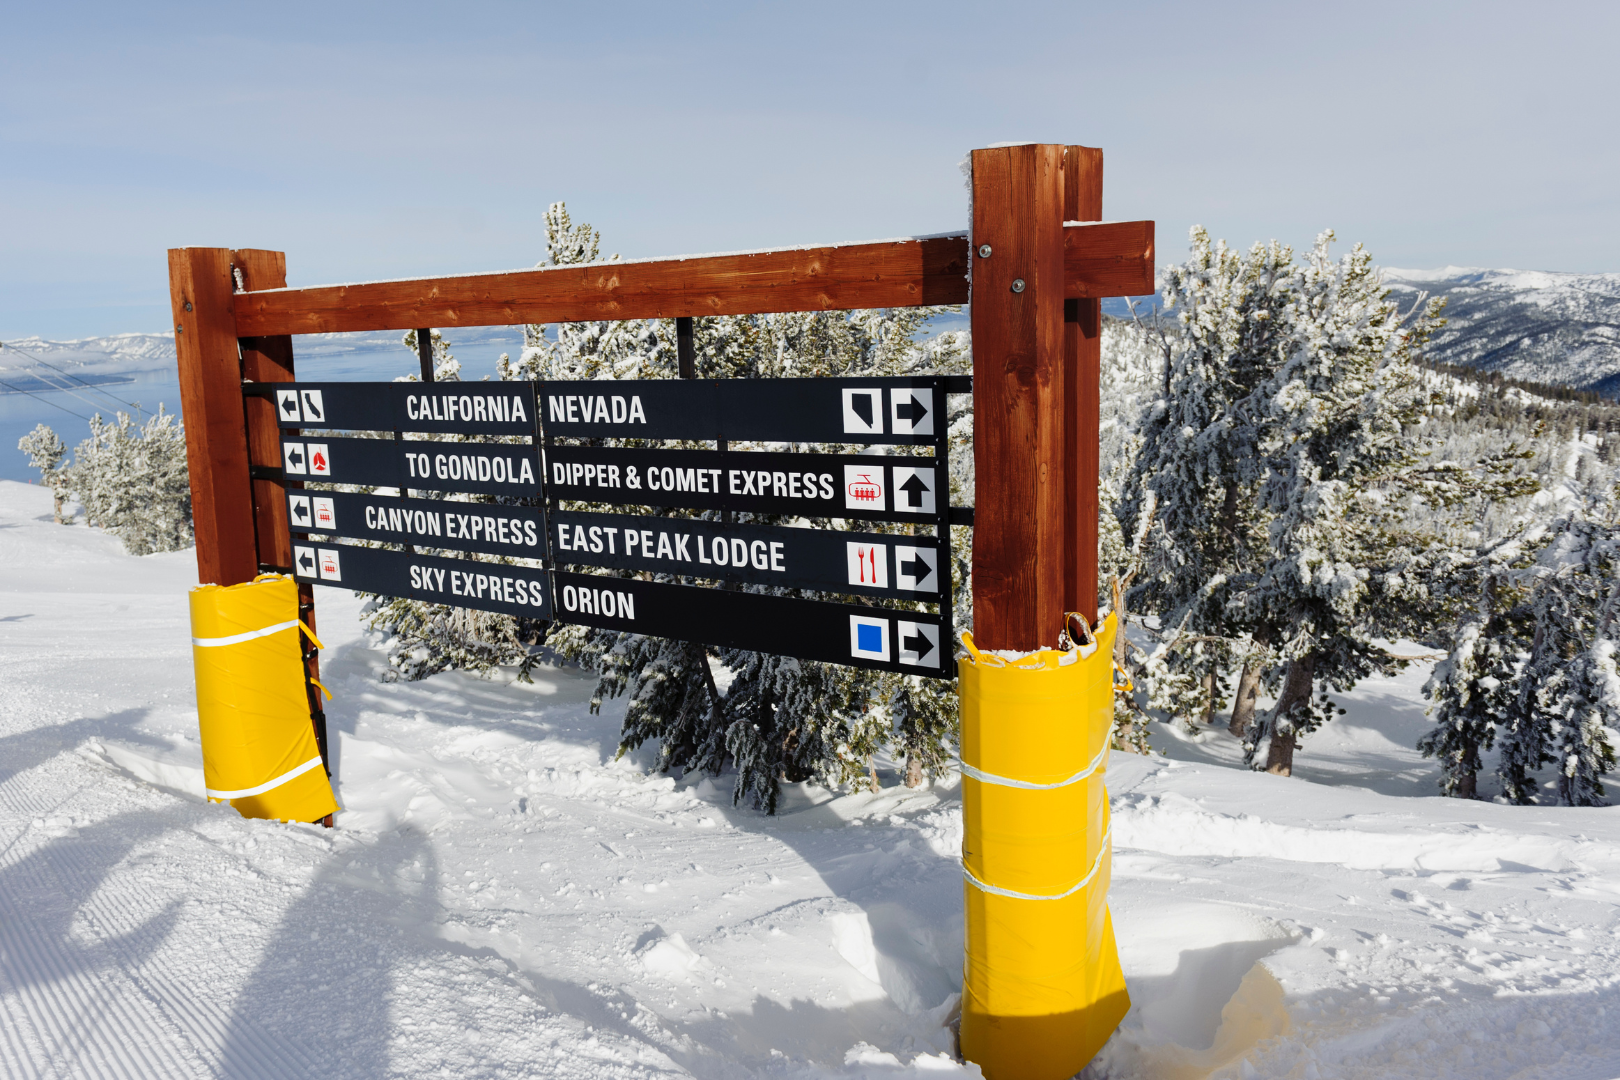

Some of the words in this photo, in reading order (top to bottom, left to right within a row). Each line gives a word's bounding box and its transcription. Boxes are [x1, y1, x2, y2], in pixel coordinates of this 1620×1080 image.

[406, 394, 527, 422] CALIFORNIA
[549, 395, 647, 424] NEVADA
[405, 452, 431, 478] TO
[435, 454, 535, 485] GONDOLA
[552, 462, 621, 489] DIPPER
[625, 465, 642, 490] &
[647, 466, 722, 493] COMET
[728, 470, 835, 499] EXPRESS
[365, 505, 441, 535] CANYON
[446, 513, 538, 545] EXPRESS
[557, 523, 618, 553] EAST
[625, 528, 691, 563] PEAK
[697, 535, 786, 571] LODGE
[410, 564, 445, 593] SKY
[450, 570, 543, 606] EXPRESS
[562, 585, 635, 619] ORION
